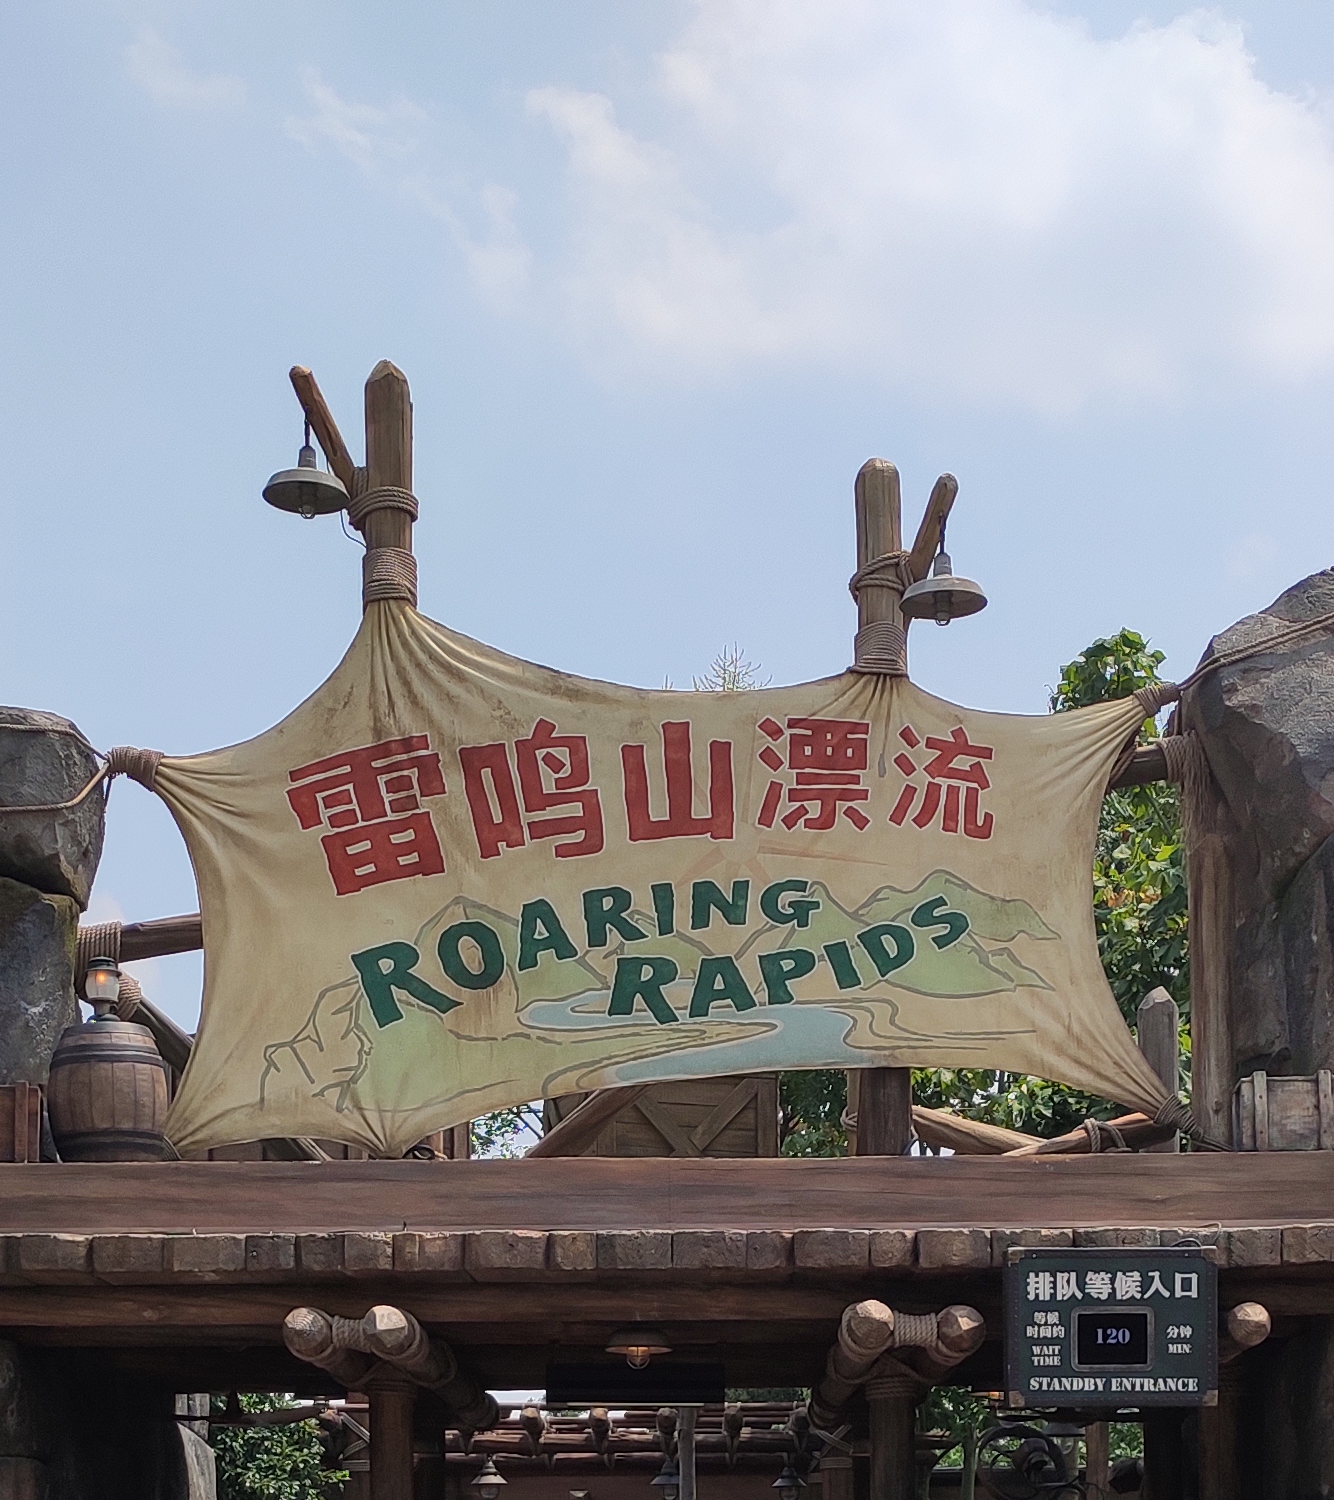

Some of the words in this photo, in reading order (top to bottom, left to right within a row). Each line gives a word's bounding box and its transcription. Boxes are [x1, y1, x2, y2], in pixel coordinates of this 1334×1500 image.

[286, 717, 995, 896] 雷鸣山漂流
[352, 879, 821, 1028] ROARING
[608, 896, 971, 1026] RAPIDS
[1026, 1271, 1198, 1301] 排队等候入口
[1033, 1311, 1060, 1324] 等候
[1026, 1325, 1065, 1338] 时间约
[1096, 1328, 1130, 1344] 120
[1166, 1325, 1192, 1338] 分钟
[1032, 1345, 1061, 1355] WAIT
[1032, 1356, 1061, 1366] TIME
[1030, 1377, 1106, 1391] STANDBY
[1110, 1377, 1198, 1392] ENTRANCE
